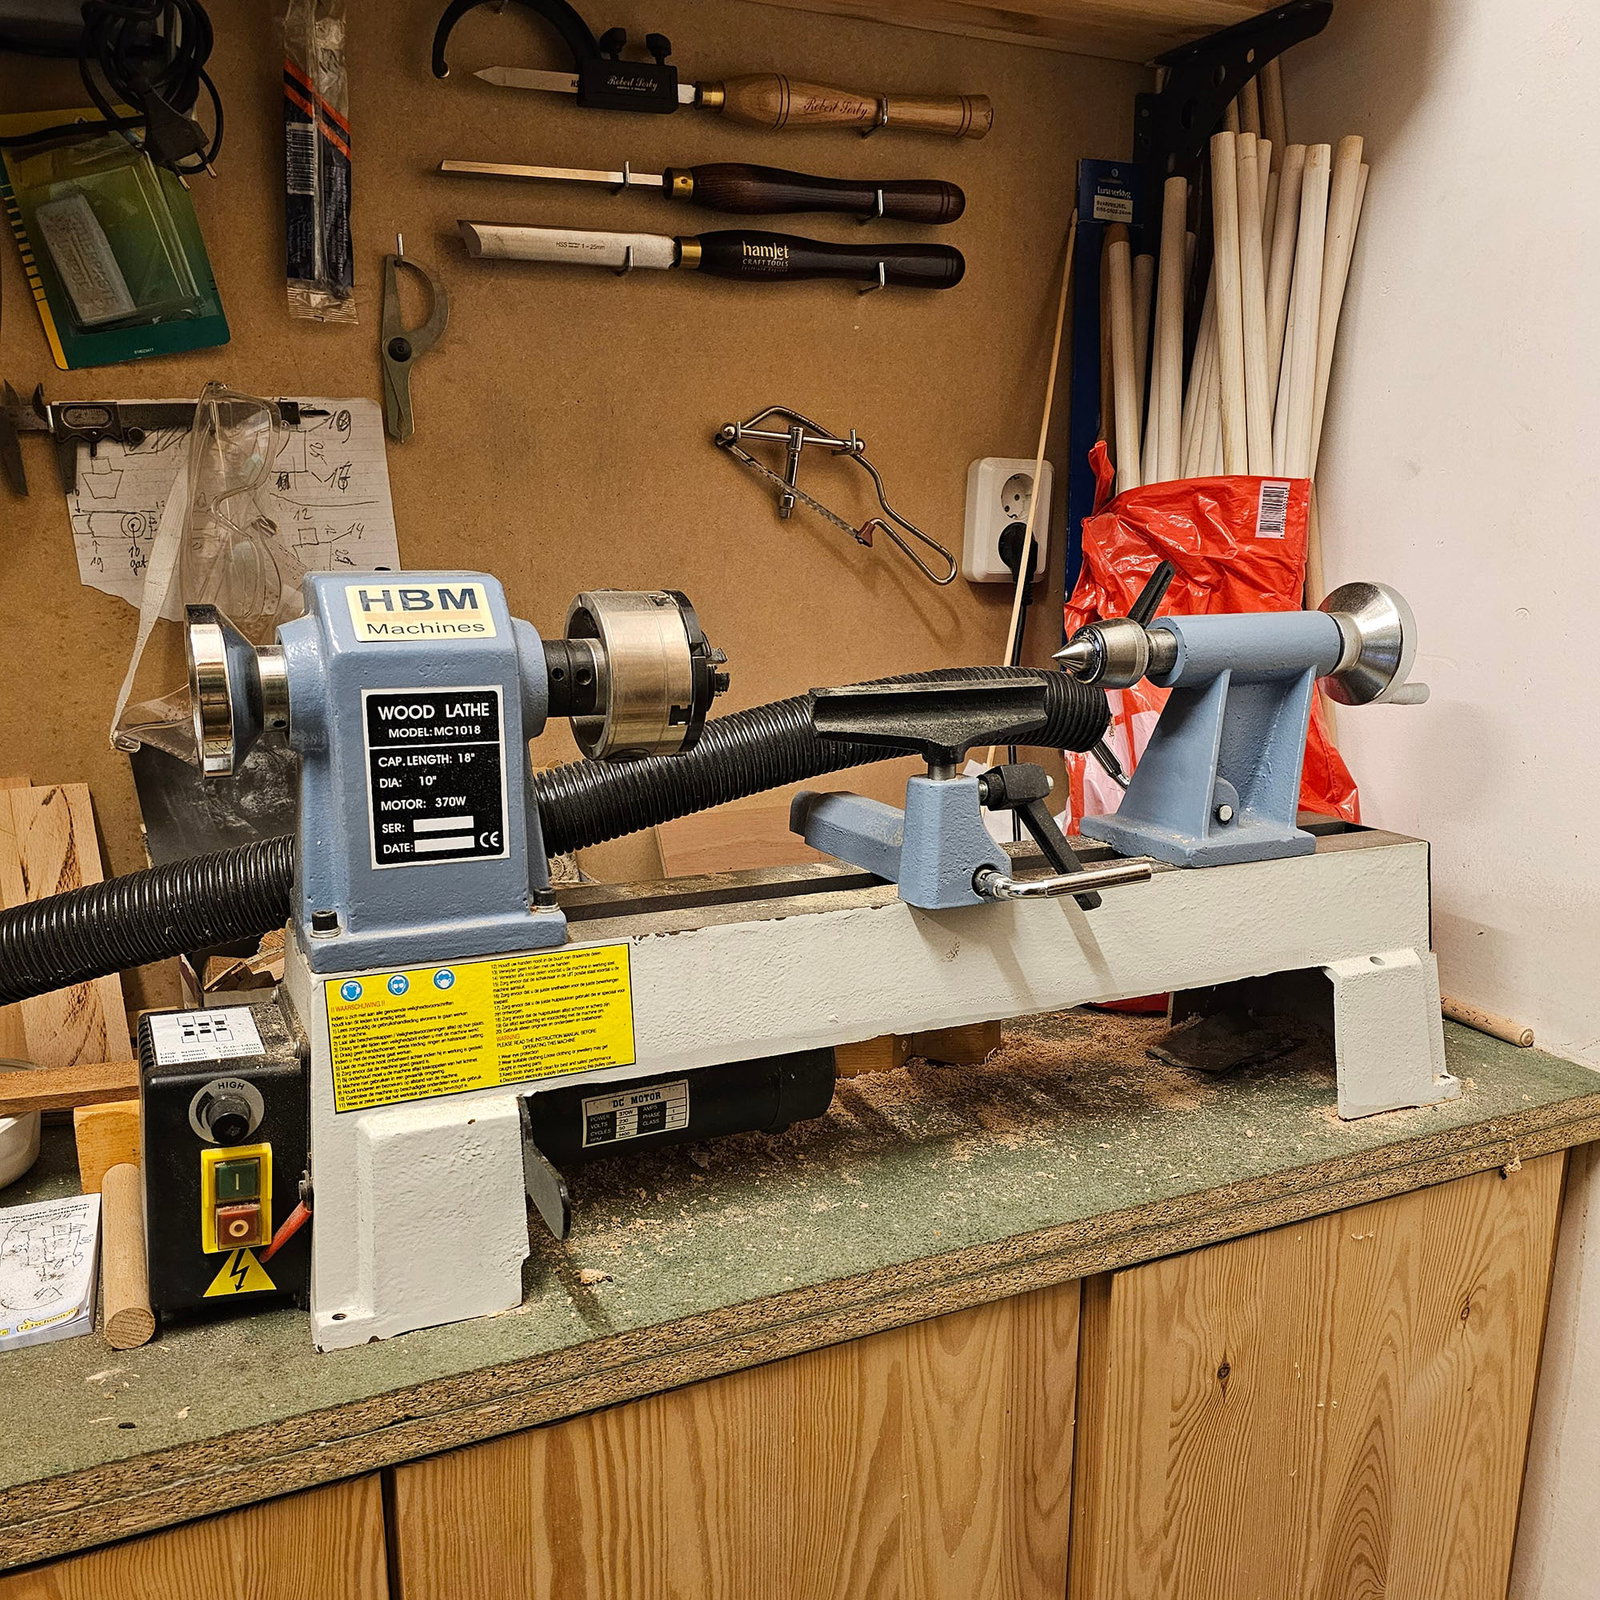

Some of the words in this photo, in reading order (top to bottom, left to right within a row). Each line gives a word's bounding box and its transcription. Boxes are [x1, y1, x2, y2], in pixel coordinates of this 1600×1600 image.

[607, 75, 633, 86] Robert
[636, 77, 658, 92] Sorby
[804, 96, 838, 113] Robert
[839, 98, 869, 120] Sorby
[742, 240, 790, 261] hamlet
[358, 587, 479, 613] HBM
[366, 621, 485, 635] Machines
[377, 704, 435, 721] WOOD
[445, 702, 490, 718] LATHE
[457, 752, 475, 764] 18"
[379, 777, 403, 789] DIA:
[418, 775, 437, 787] 10"
[380, 799, 427, 811] MOTOR:
[435, 796, 467, 808] 370W
[382, 822, 405, 834] SER:
[383, 842, 414, 854] DATE:
[218, 1080, 245, 1092] HIGH
[612, 1097, 625, 1109] DC
[630, 1091, 662, 1105] MOTOR
[590, 1114, 611, 1122] POWER
[642, 1111, 661, 1120] PHASE
[590, 1122, 608, 1130] VOLTS
[642, 1118, 660, 1127] CLASS
[590, 1128, 612, 1137] CYCLES
